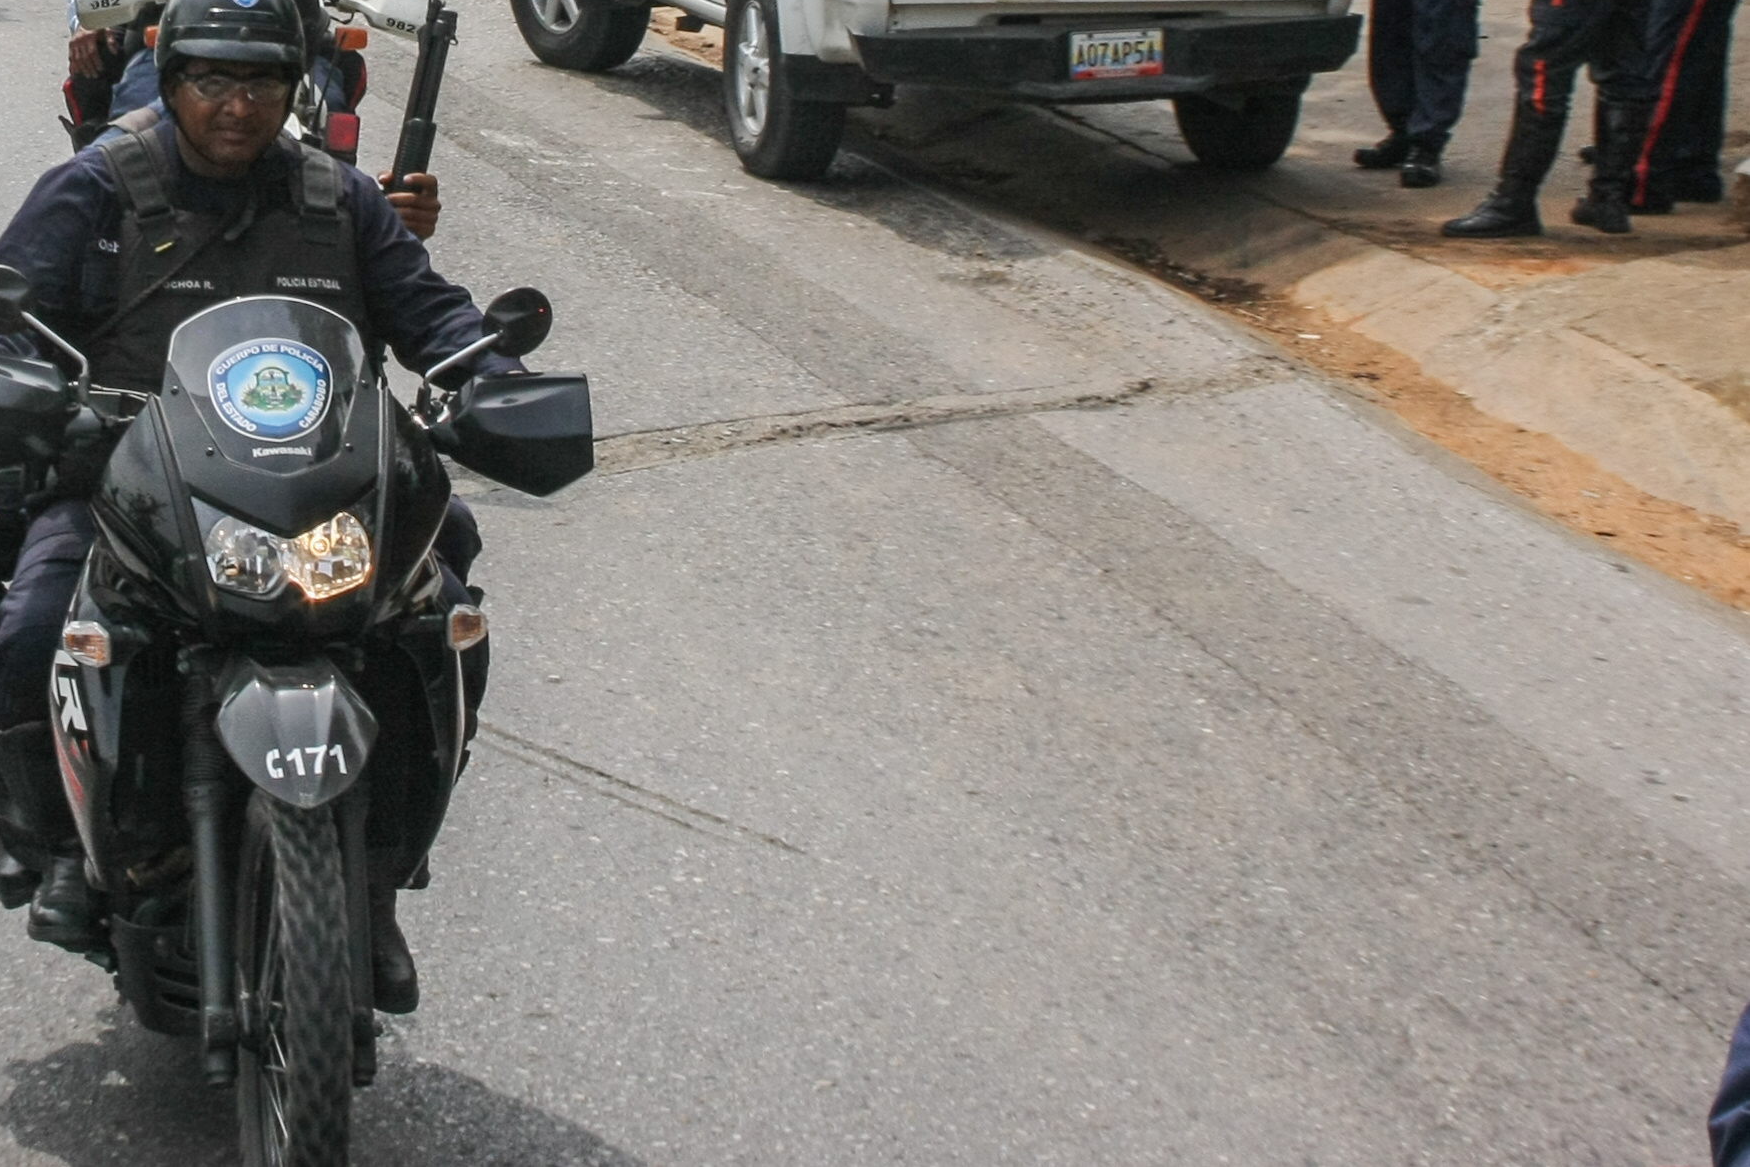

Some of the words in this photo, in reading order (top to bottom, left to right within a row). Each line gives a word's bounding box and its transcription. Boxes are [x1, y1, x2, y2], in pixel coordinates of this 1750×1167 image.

[386, 17, 416, 34] 982
[215, 347, 261, 376] CUERPO
[262, 344, 279, 353] DE
[215, 382, 229, 403] DEL
[297, 378, 327, 429] CARABOBO
[221, 401, 258, 433] ESTADO
[251, 446, 313, 458] Kawasaki
[265, 744, 348, 780] C171
